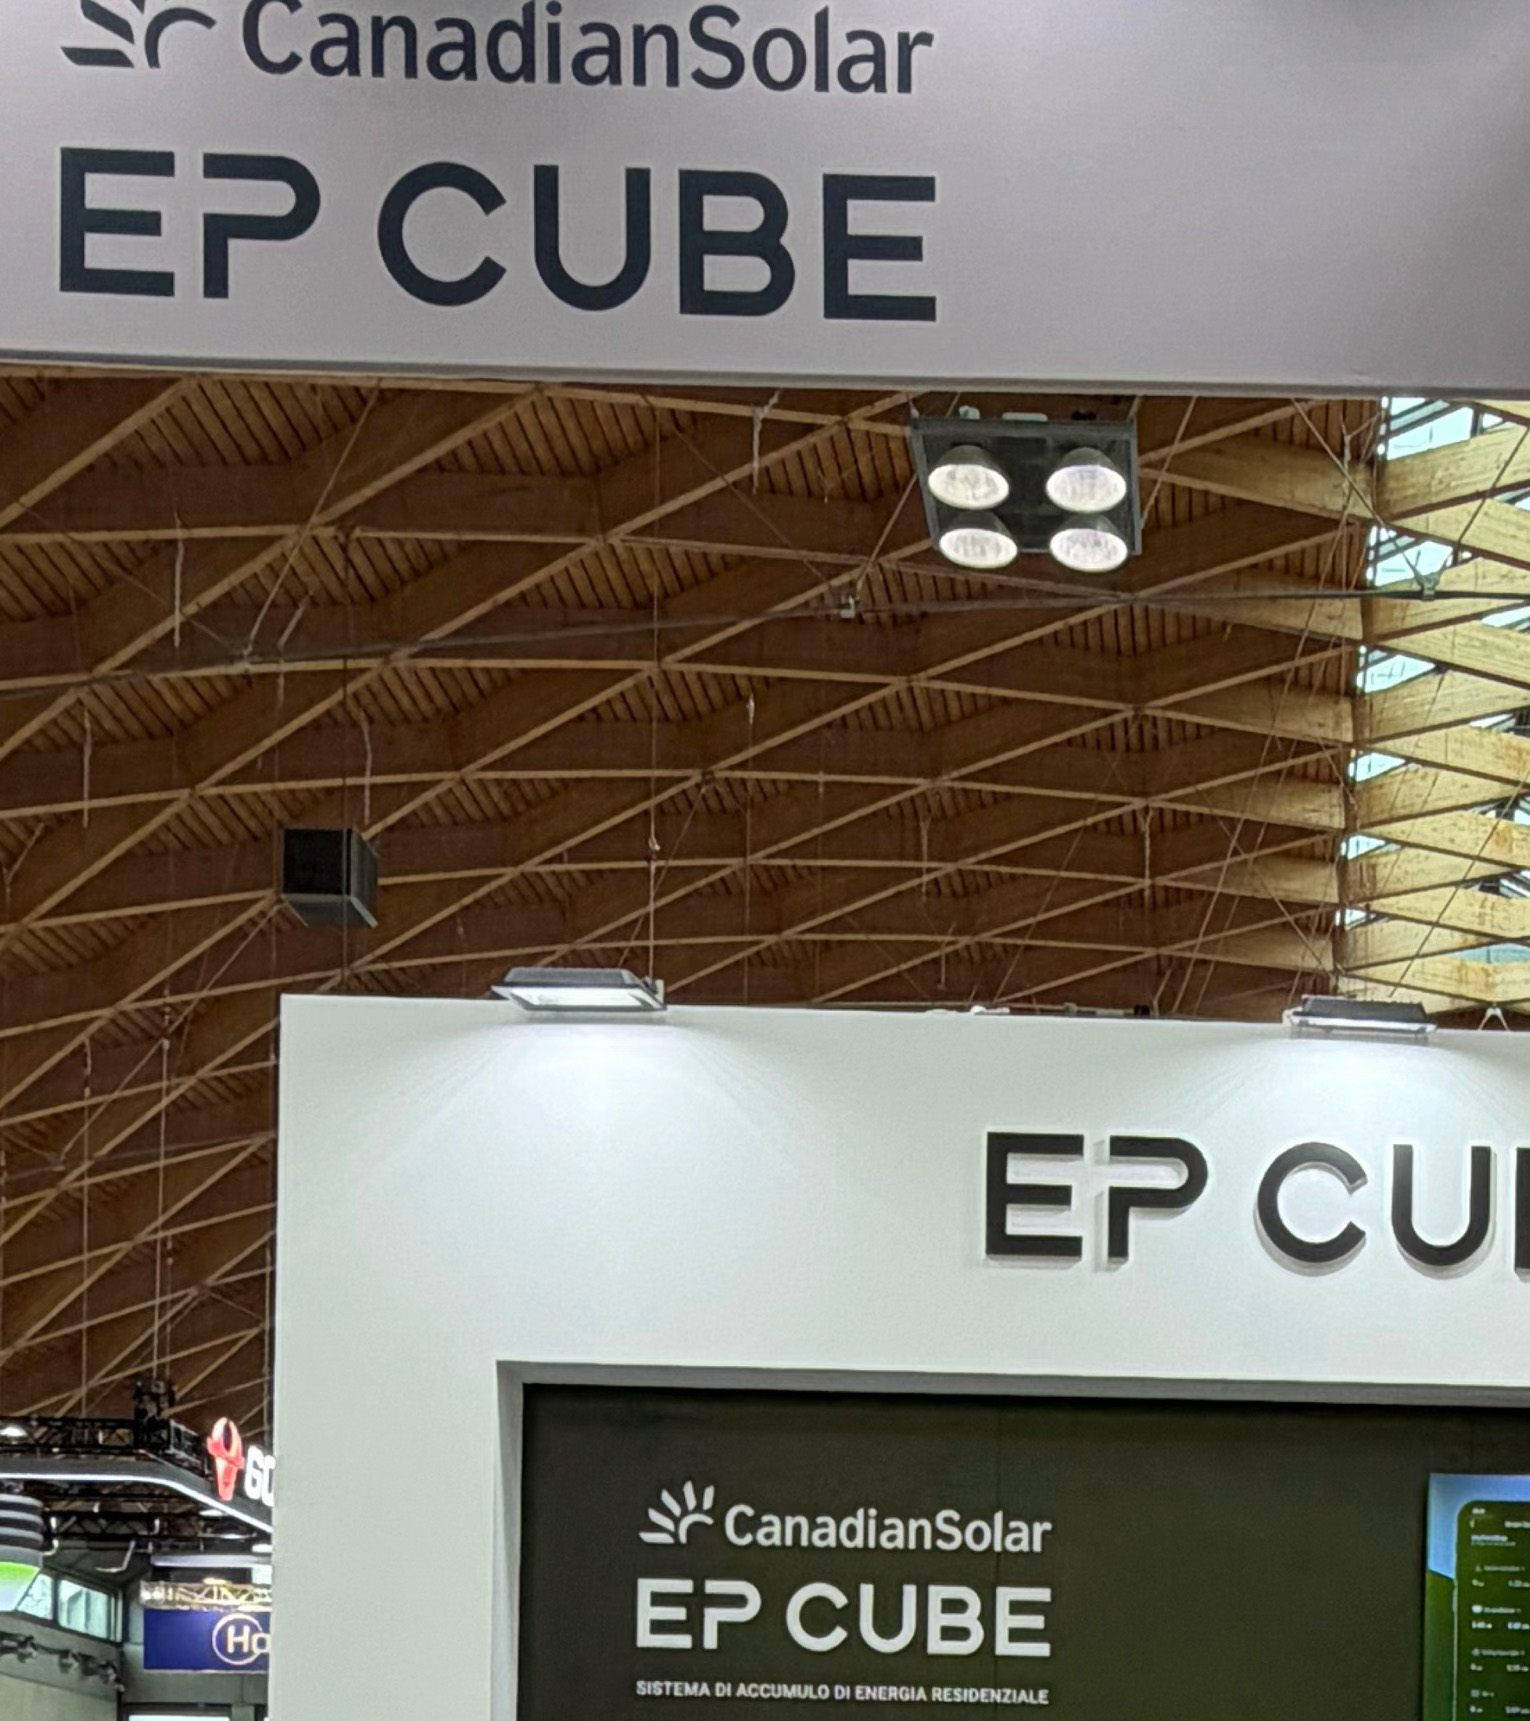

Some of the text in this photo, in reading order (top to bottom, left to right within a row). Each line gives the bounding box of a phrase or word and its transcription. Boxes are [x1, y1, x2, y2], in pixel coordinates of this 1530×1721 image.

[241, 0, 934, 96] CanadianSolar
[59, 146, 937, 322] EP CUBE
[985, 1131, 1209, 1266] EP
[724, 1503, 1052, 1553] CanadianSolar
[635, 1576, 1052, 1658] EP CUBE
[635, 1680, 1049, 1705] SISTEMA DI ACCUMULO DI ENERGIA RESIDENZIALE
